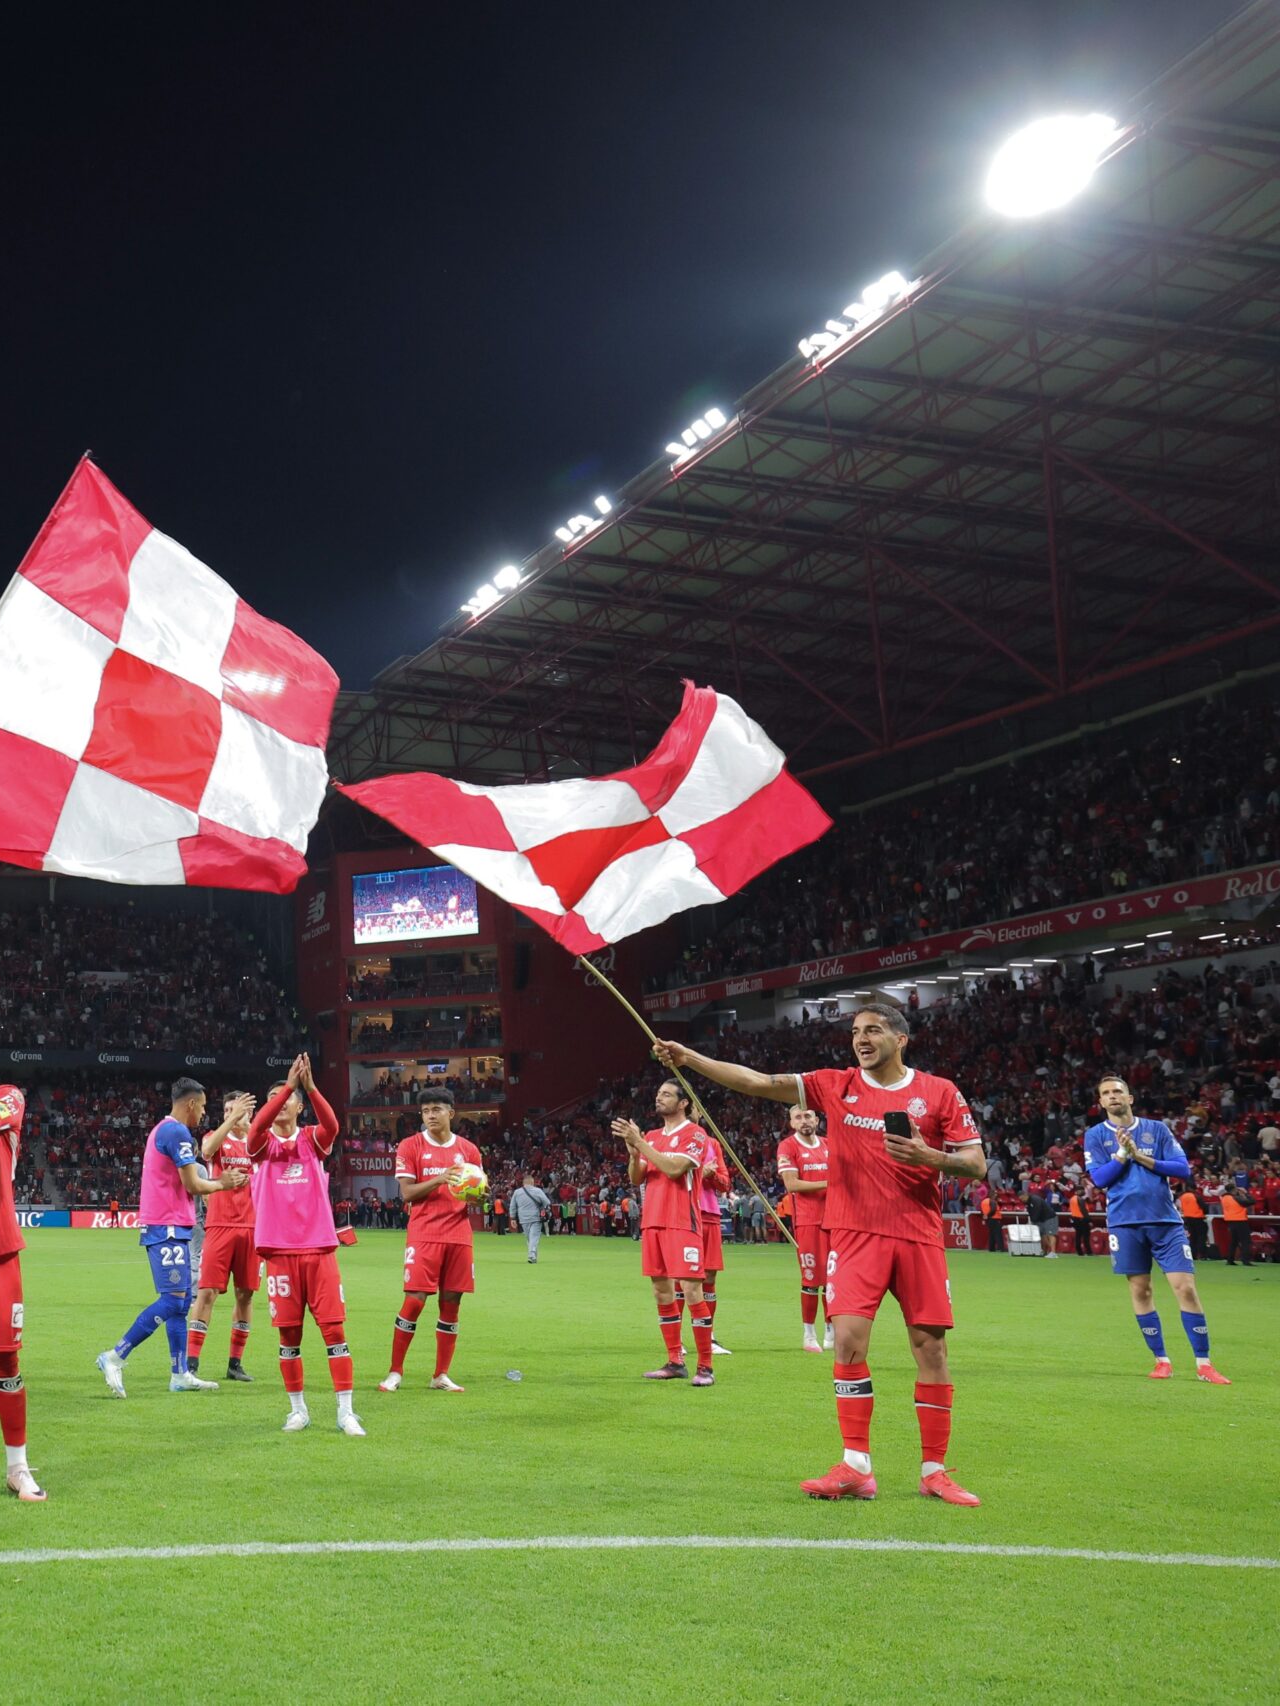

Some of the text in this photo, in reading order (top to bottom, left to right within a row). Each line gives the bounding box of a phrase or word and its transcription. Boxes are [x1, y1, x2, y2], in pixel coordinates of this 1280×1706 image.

[1224, 872, 1264, 900] Red
[1065, 890, 1189, 925] VOLVO
[998, 920, 1054, 943] Electrolit
[878, 947, 918, 967] volaris
[798, 959, 844, 982] Red Cola
[10, 1051, 43, 1063] Corona
[98, 1052, 130, 1064] Corona
[185, 1054, 216, 1066] Corona
[349, 1157, 393, 1171] ESTADIO
[288, 1177, 309, 1185] balance
[160, 1245, 186, 1267] 22
[800, 1252, 815, 1268] 16
[267, 1275, 291, 1298] 85
